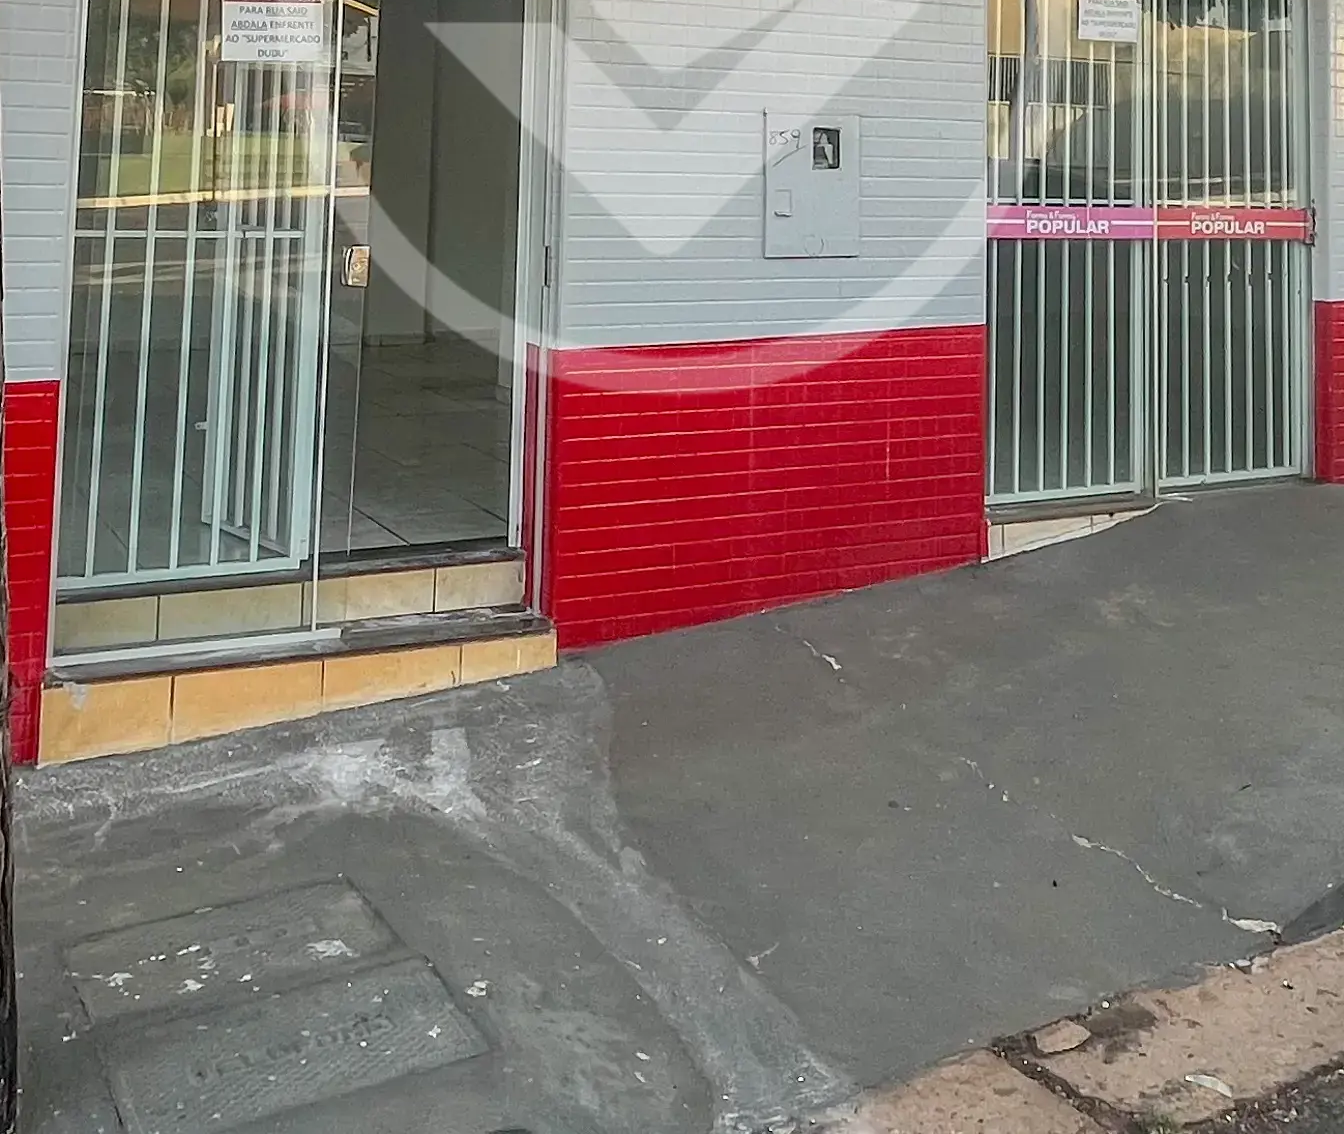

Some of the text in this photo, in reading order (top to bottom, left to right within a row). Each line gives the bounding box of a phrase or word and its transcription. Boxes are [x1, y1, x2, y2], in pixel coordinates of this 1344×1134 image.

[239, 6, 263, 15] PARA
[266, 6, 285, 15] RUA
[231, 20, 315, 29] ABDALA ENFRENTE
[225, 34, 239, 43] AO
[1026, 219, 1110, 234] POPULAR
[1191, 220, 1265, 234] POPULAR
